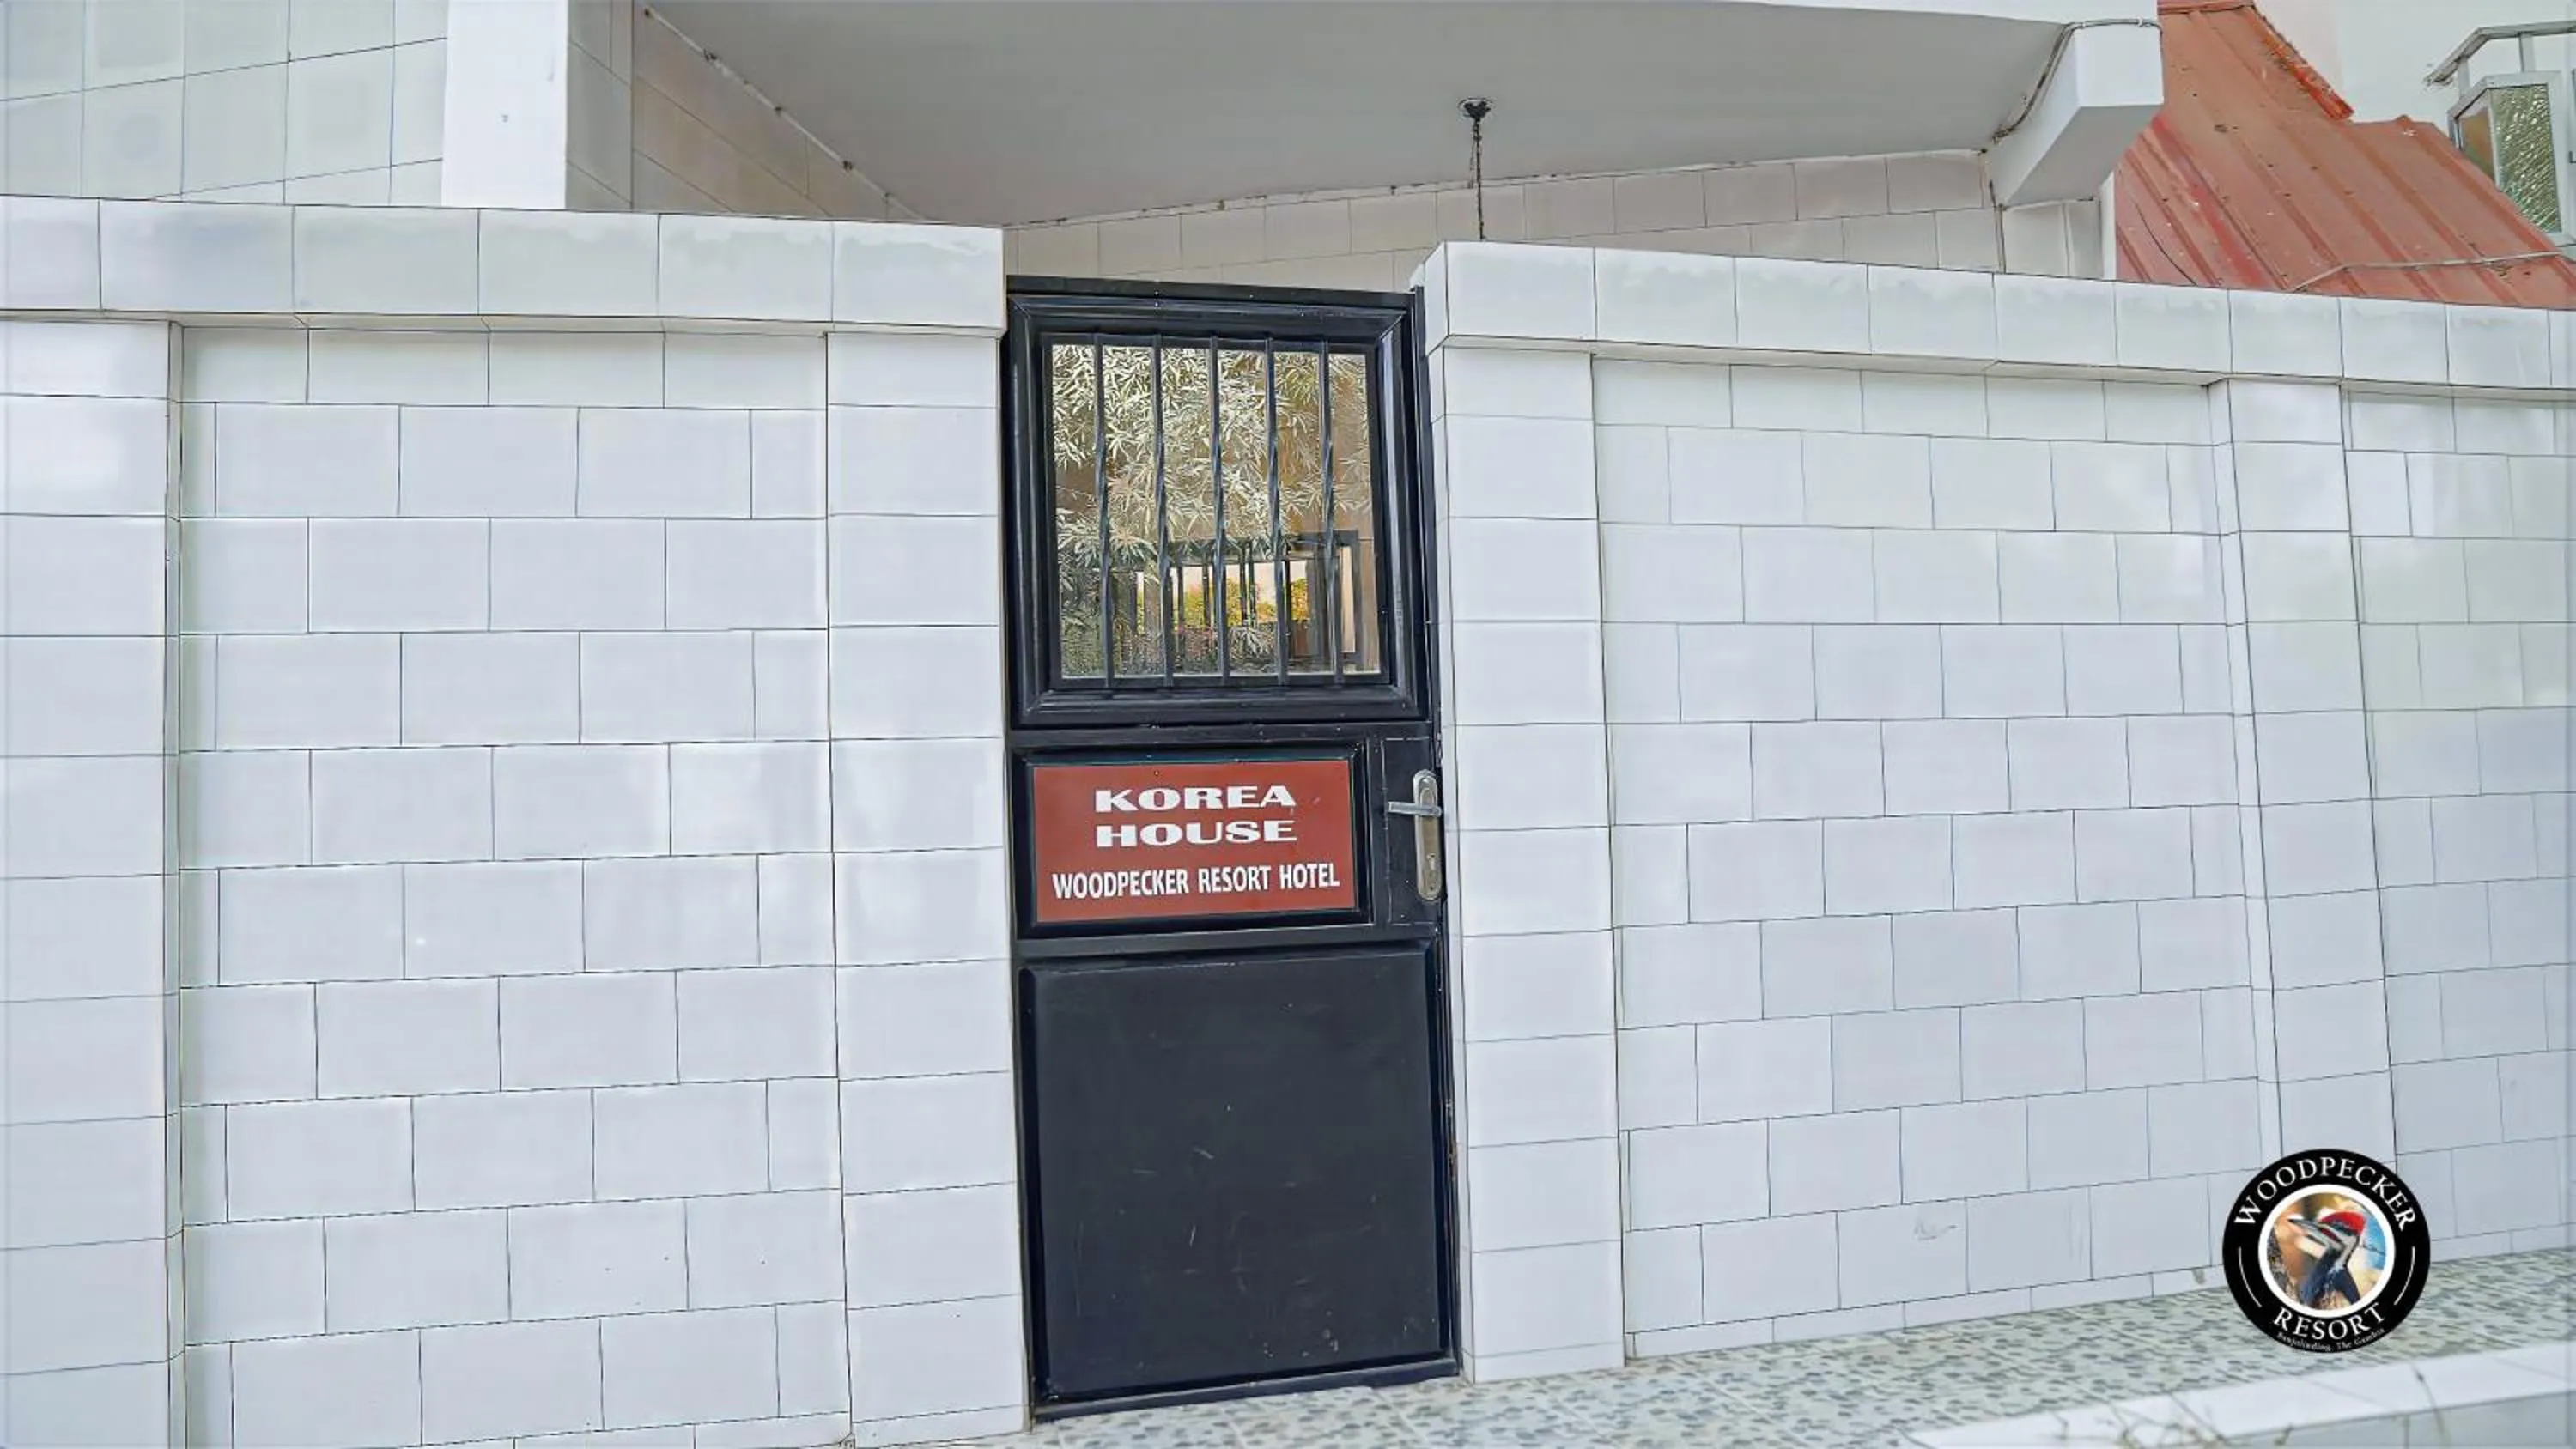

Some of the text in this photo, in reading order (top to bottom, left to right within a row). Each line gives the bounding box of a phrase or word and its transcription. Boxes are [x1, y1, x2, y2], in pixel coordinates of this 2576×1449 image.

[1095, 785, 1297, 813] KOREA
[1096, 820, 1297, 847] HOUSE
[1052, 862, 1340, 900] WOODPECKER RESORT HOTEL
